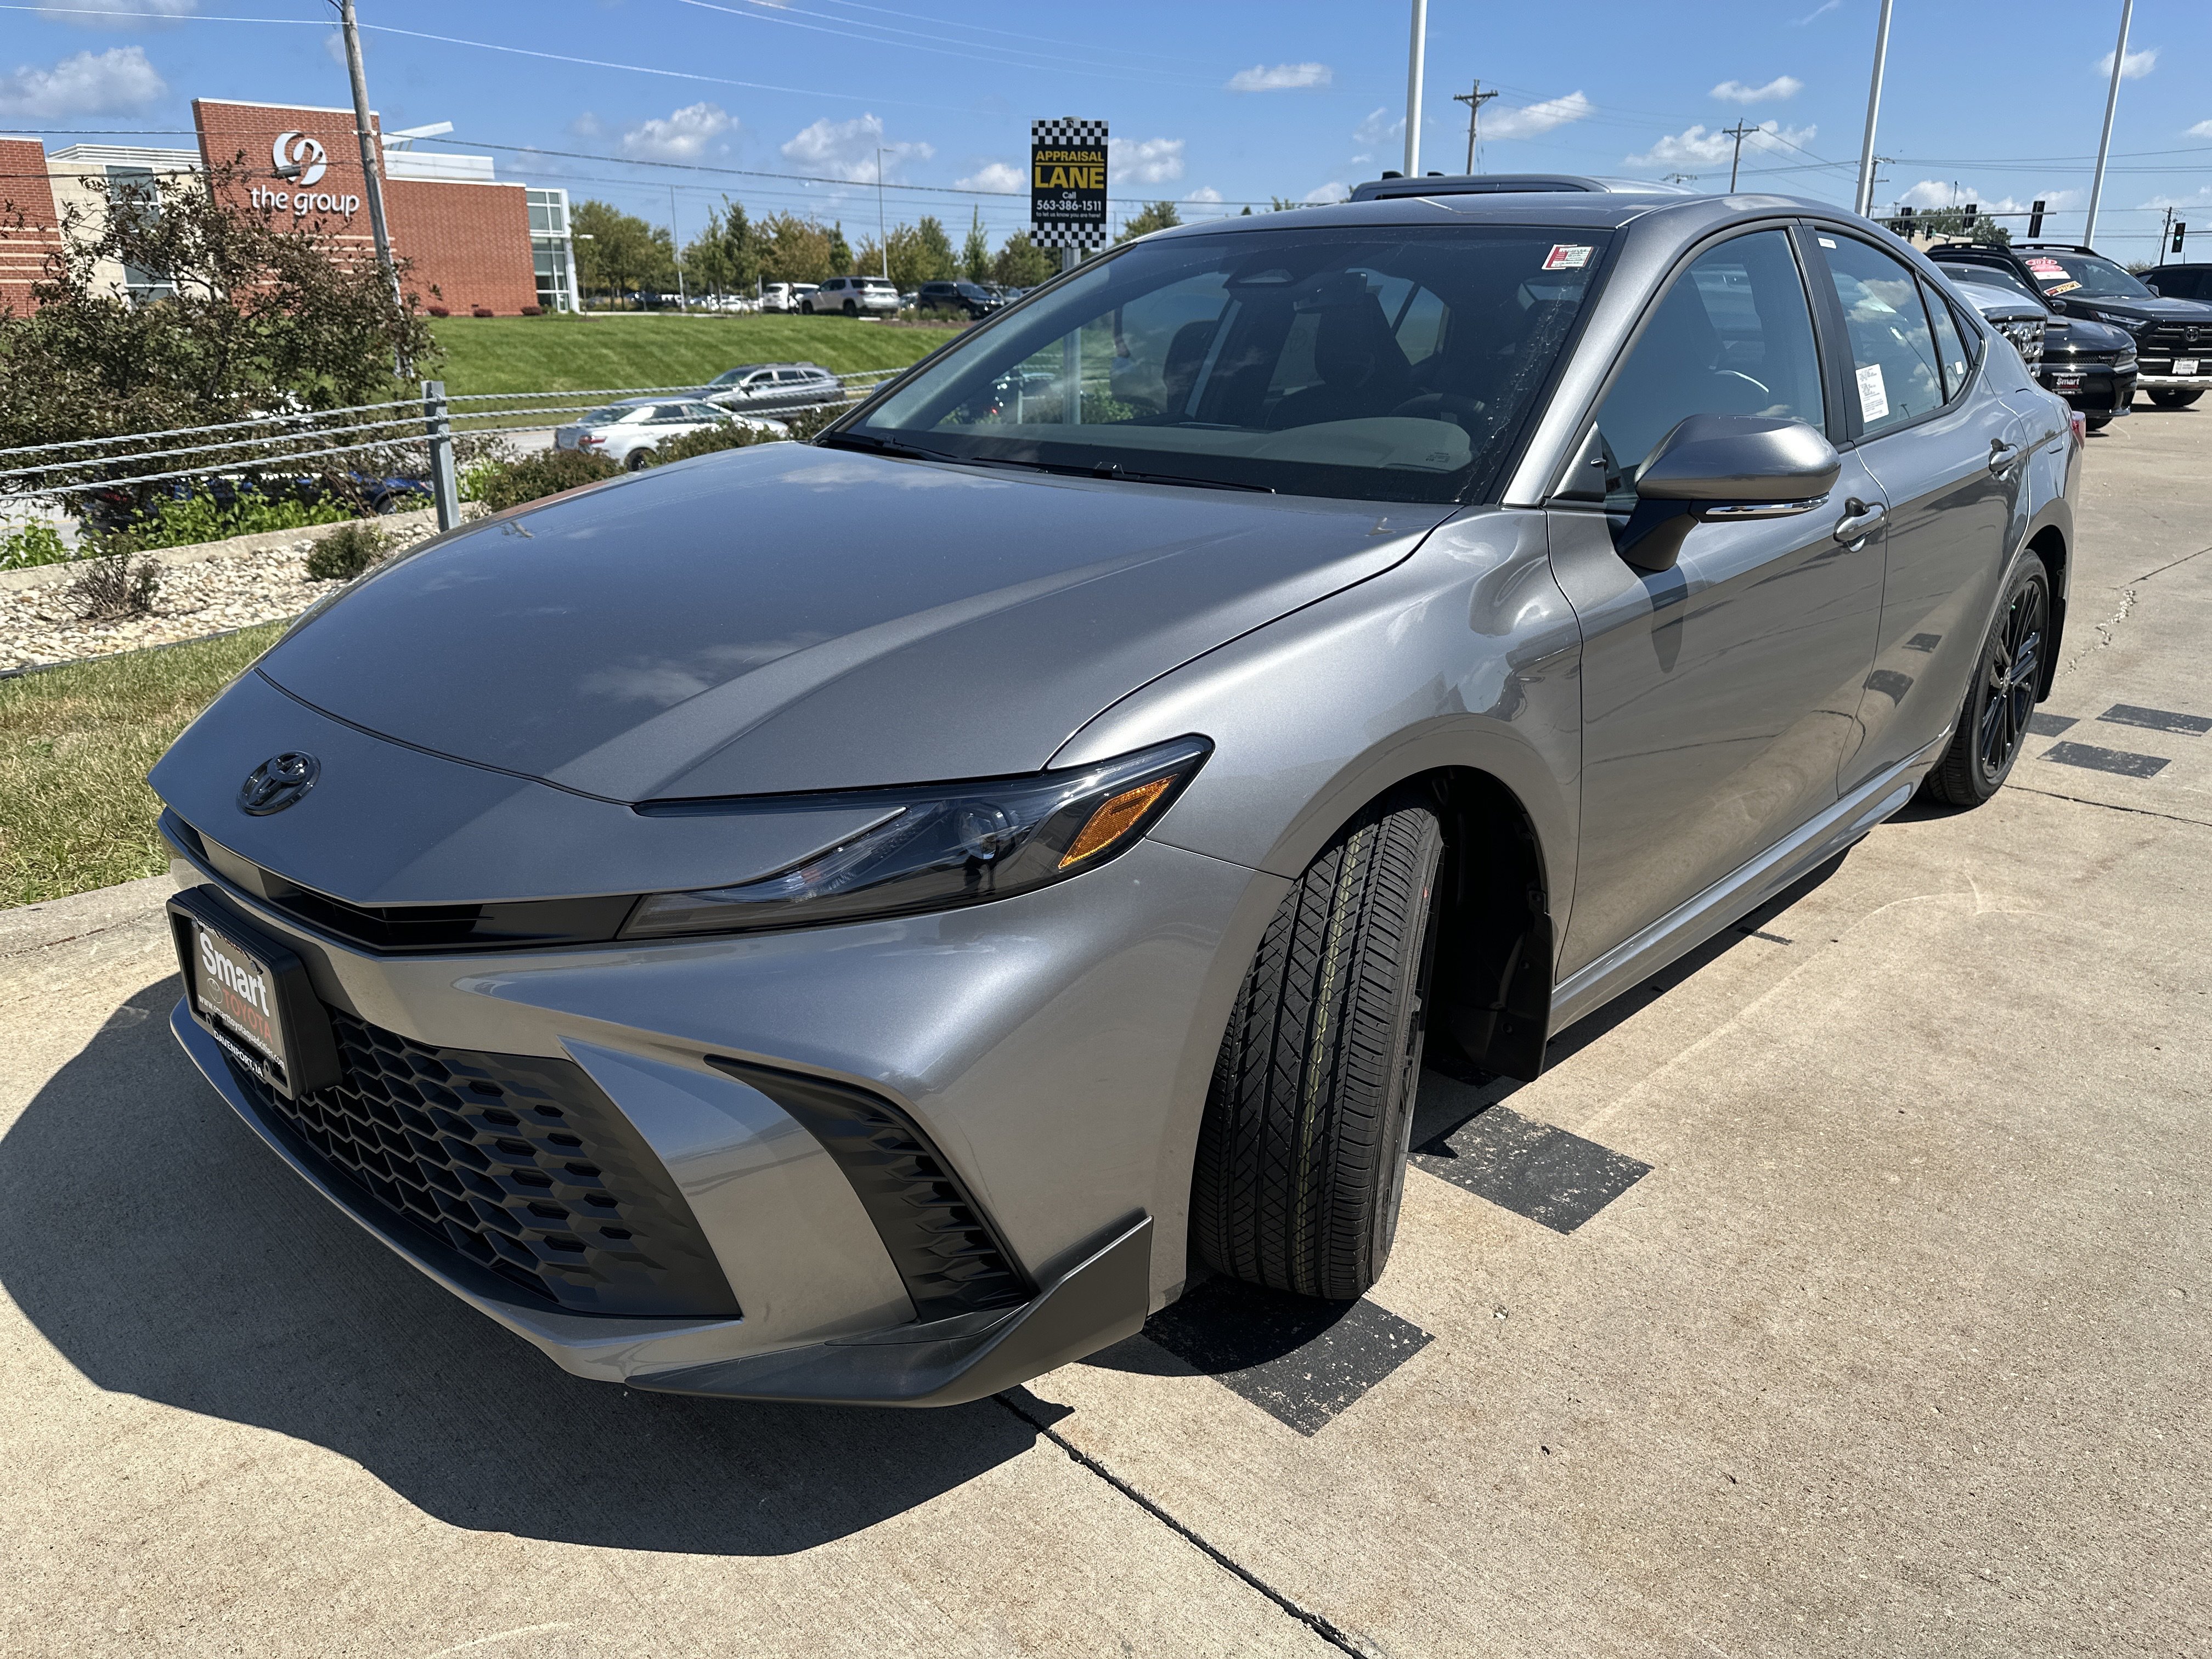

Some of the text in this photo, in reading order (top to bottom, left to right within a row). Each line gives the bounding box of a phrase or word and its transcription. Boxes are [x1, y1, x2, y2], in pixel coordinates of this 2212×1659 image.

[1035, 150, 1104, 162] APPRAISAL
[1035, 167, 1104, 189] LANE
[250, 184, 360, 217] the group
[1036, 200, 1102, 211] 563-386-1511
[200, 932, 270, 1018] Smart
[198, 994, 285, 1070] www.smarttoyotaquadcities.com
[222, 989, 273, 1044] TOYOTA
[214, 1030, 263, 1077] DAVENPORT, IA
